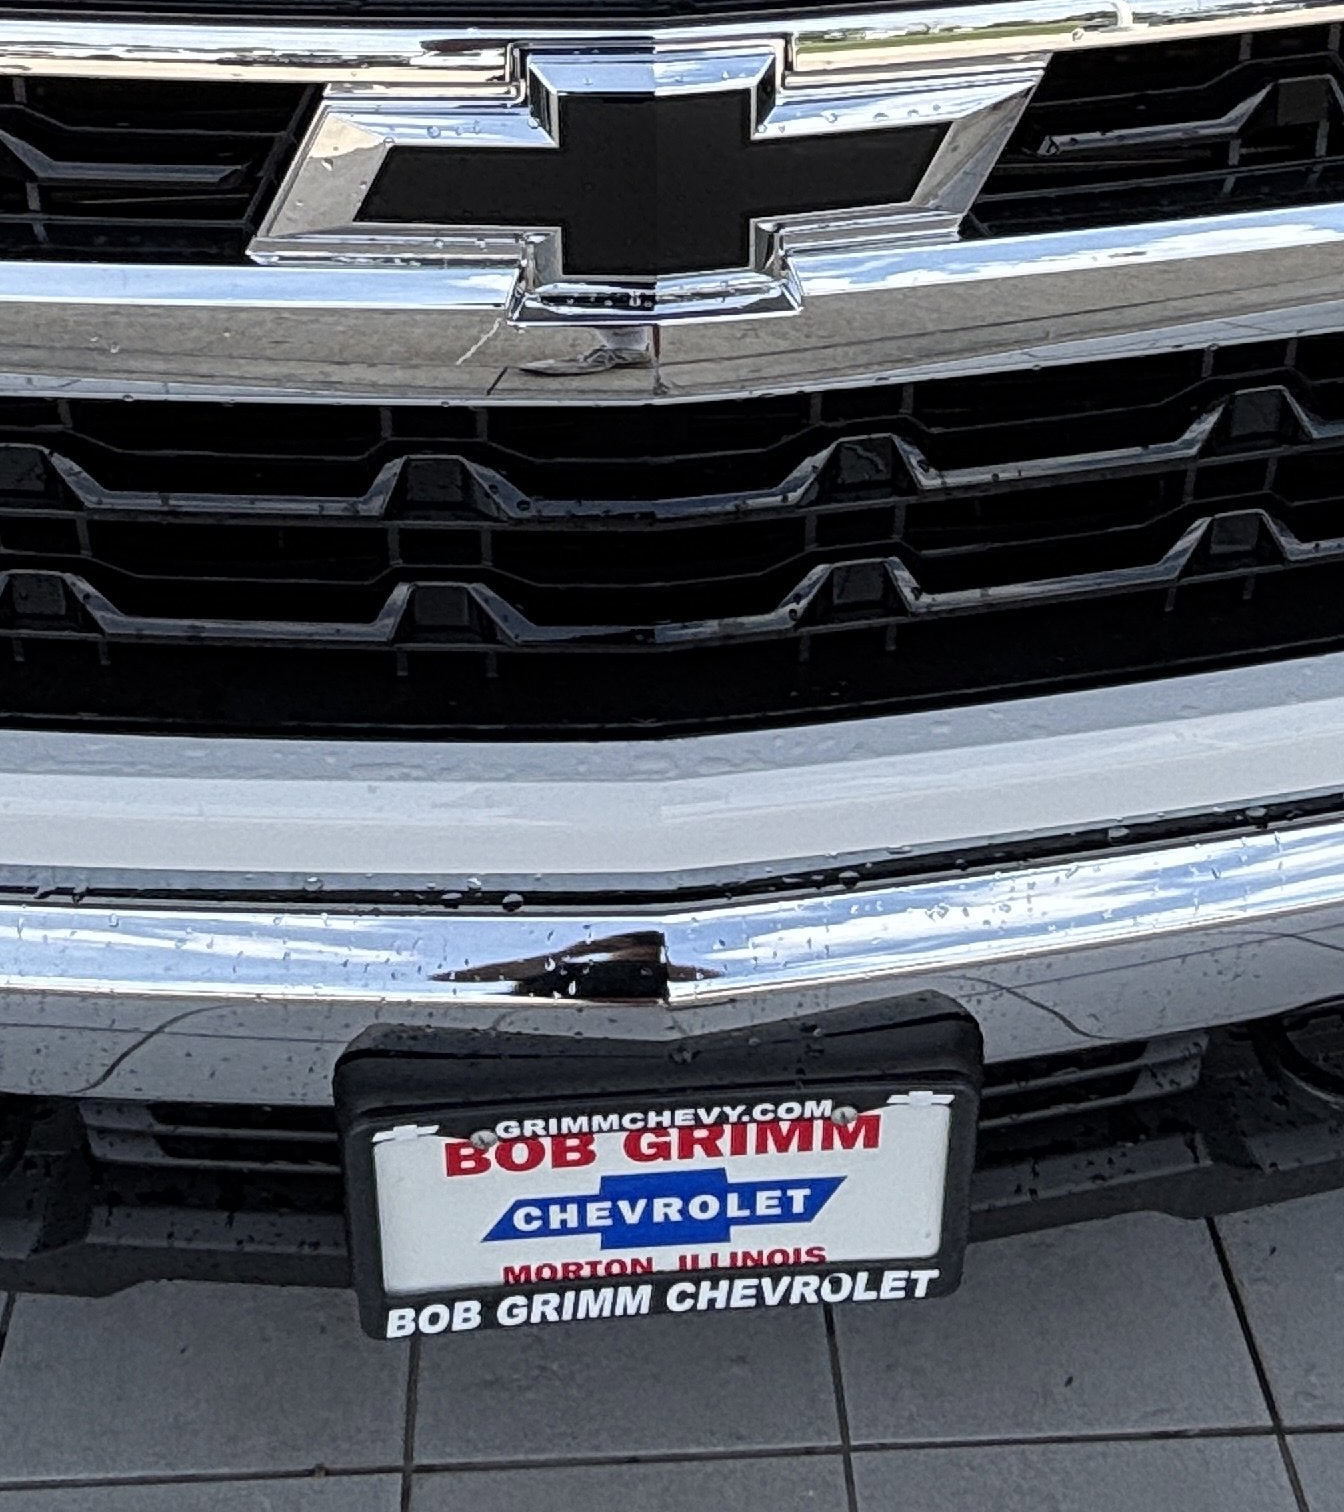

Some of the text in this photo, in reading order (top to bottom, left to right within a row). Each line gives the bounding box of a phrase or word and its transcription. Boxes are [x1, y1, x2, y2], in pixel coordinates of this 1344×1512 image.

[495, 1099, 833, 1140] GRIMMCHEVY.COM
[444, 1113, 882, 1178] BOB GRIMM
[512, 1188, 811, 1232] CHEVROLET
[502, 1256, 654, 1285] MORTON
[386, 1269, 940, 1338] BOB GRIMM CHEVROLET
